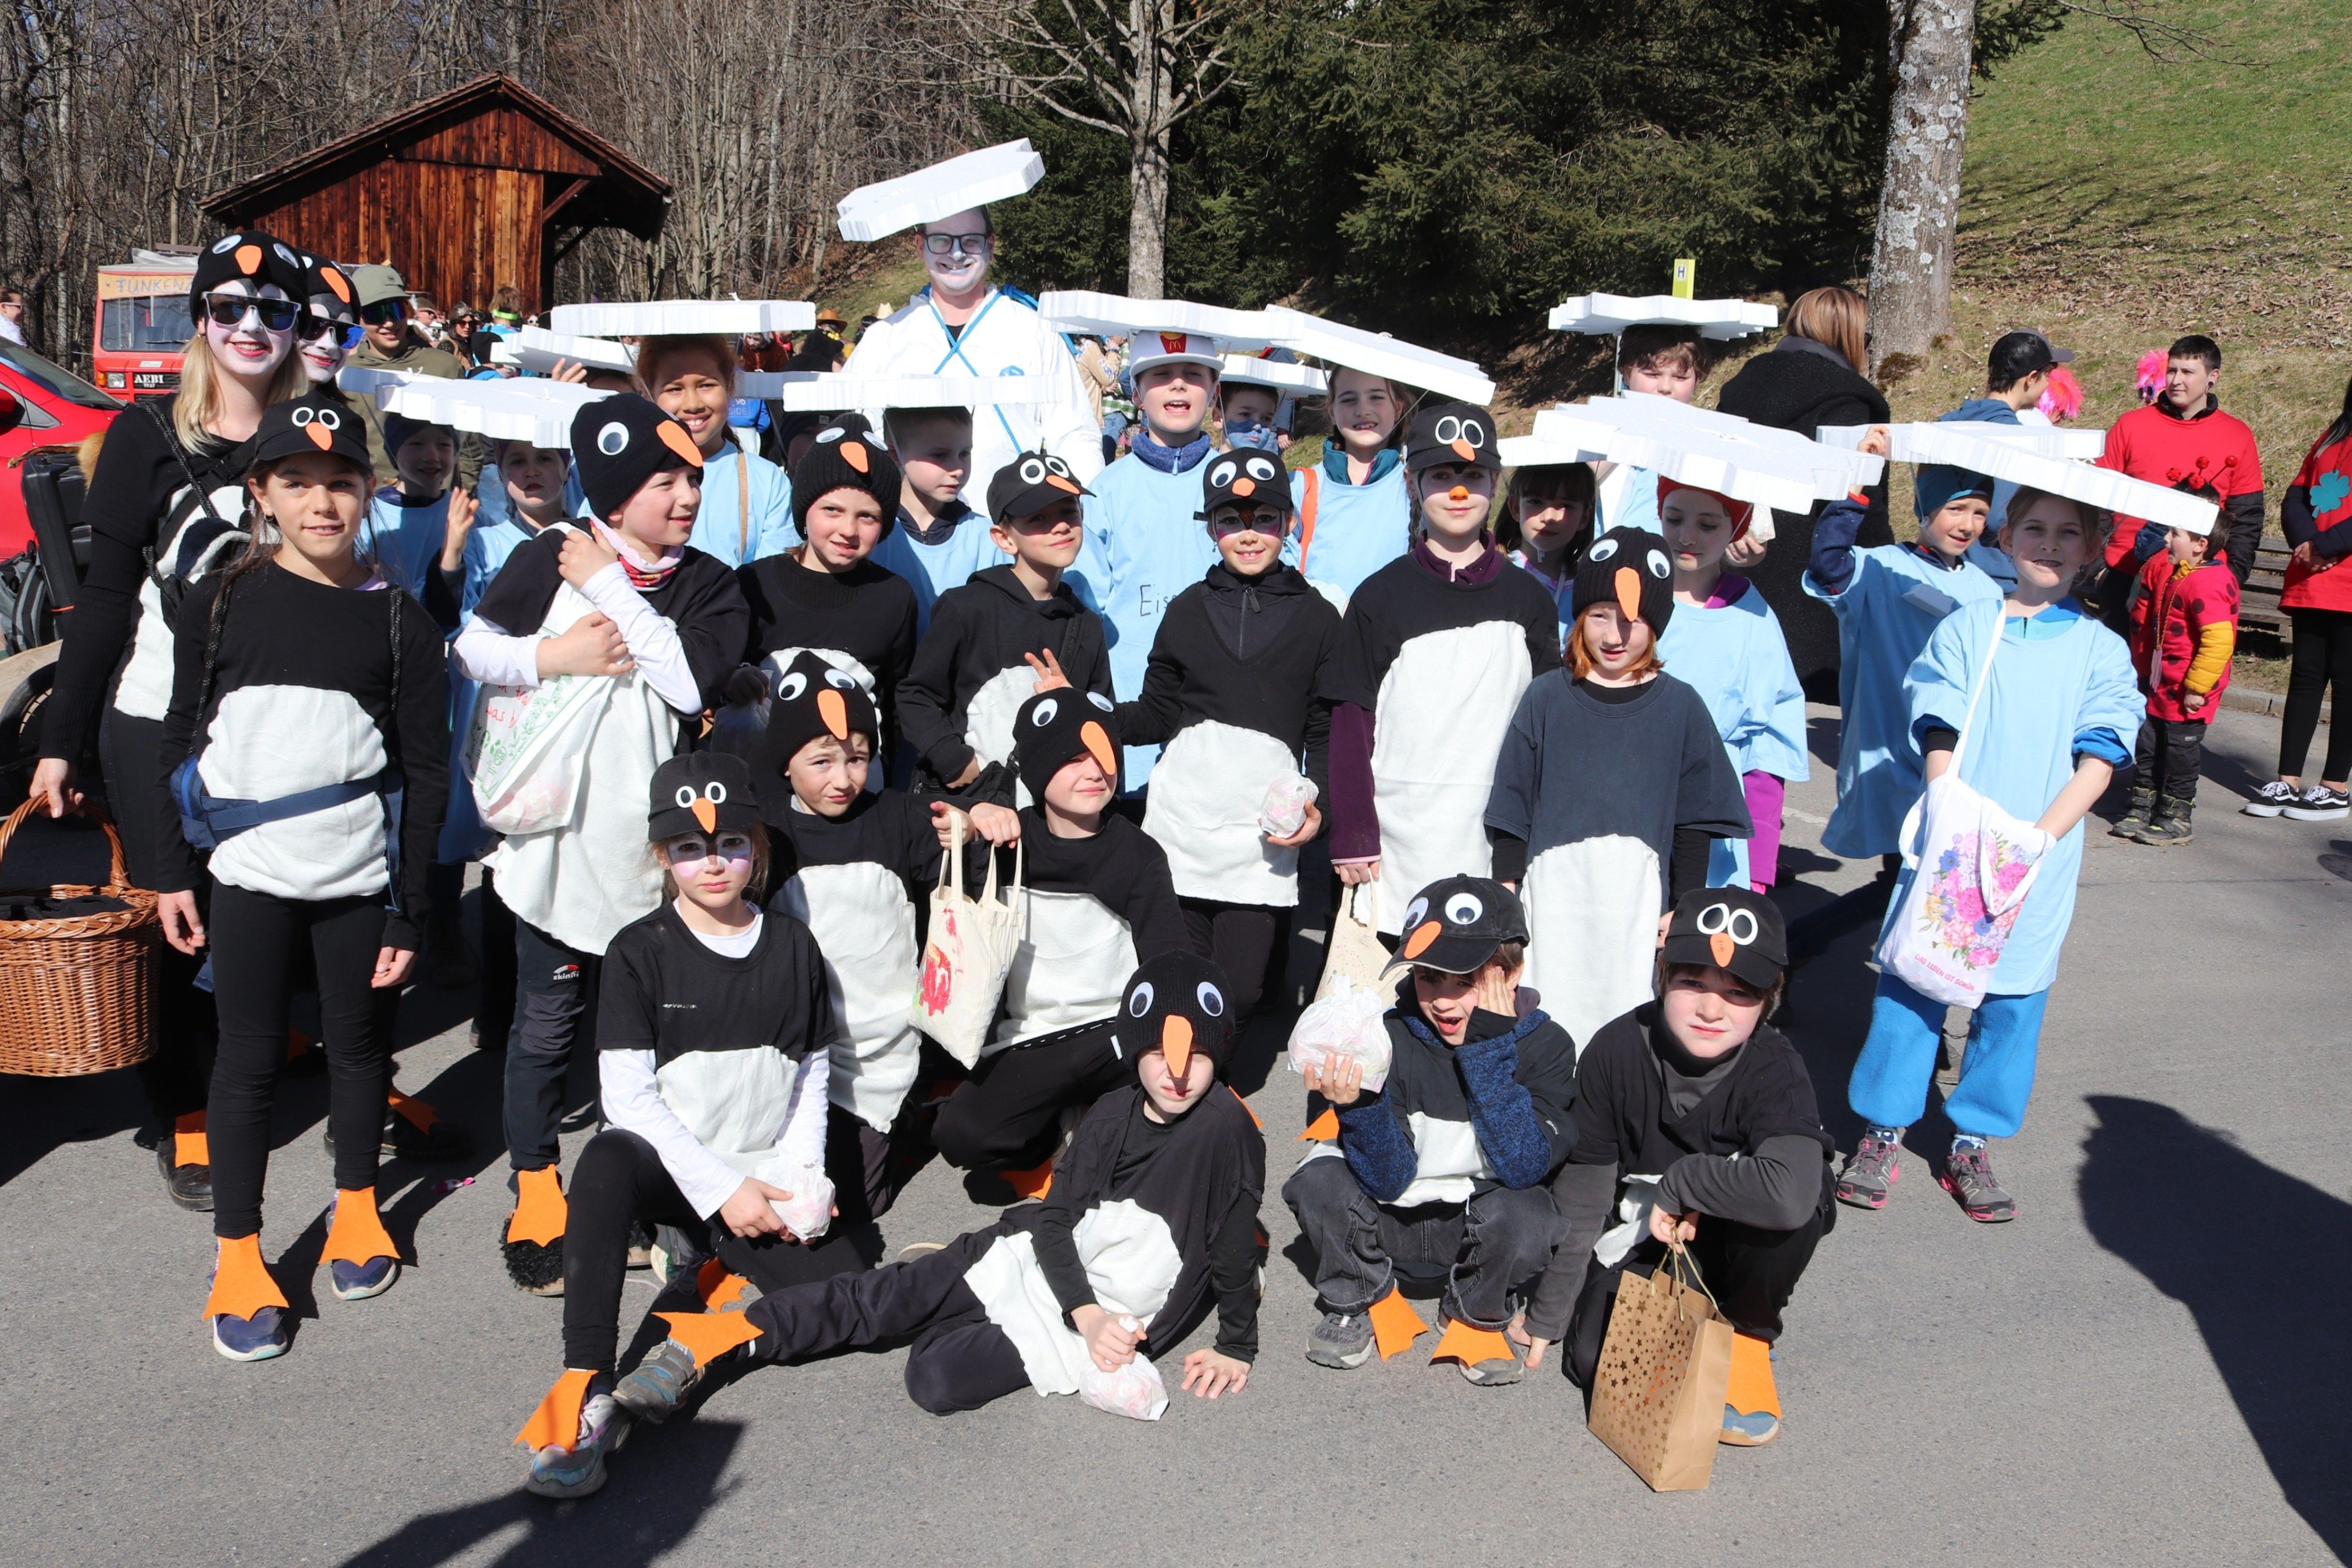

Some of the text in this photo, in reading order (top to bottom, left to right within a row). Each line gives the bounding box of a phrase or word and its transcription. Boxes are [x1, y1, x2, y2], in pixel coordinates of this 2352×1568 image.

[1677, 266, 1685, 278] H
[134, 374, 164, 384] AEBI
[1914, 953, 1928, 965] DAS
[1927, 962, 1945, 977] LEBEN
[1944, 974, 1956, 983] IST
